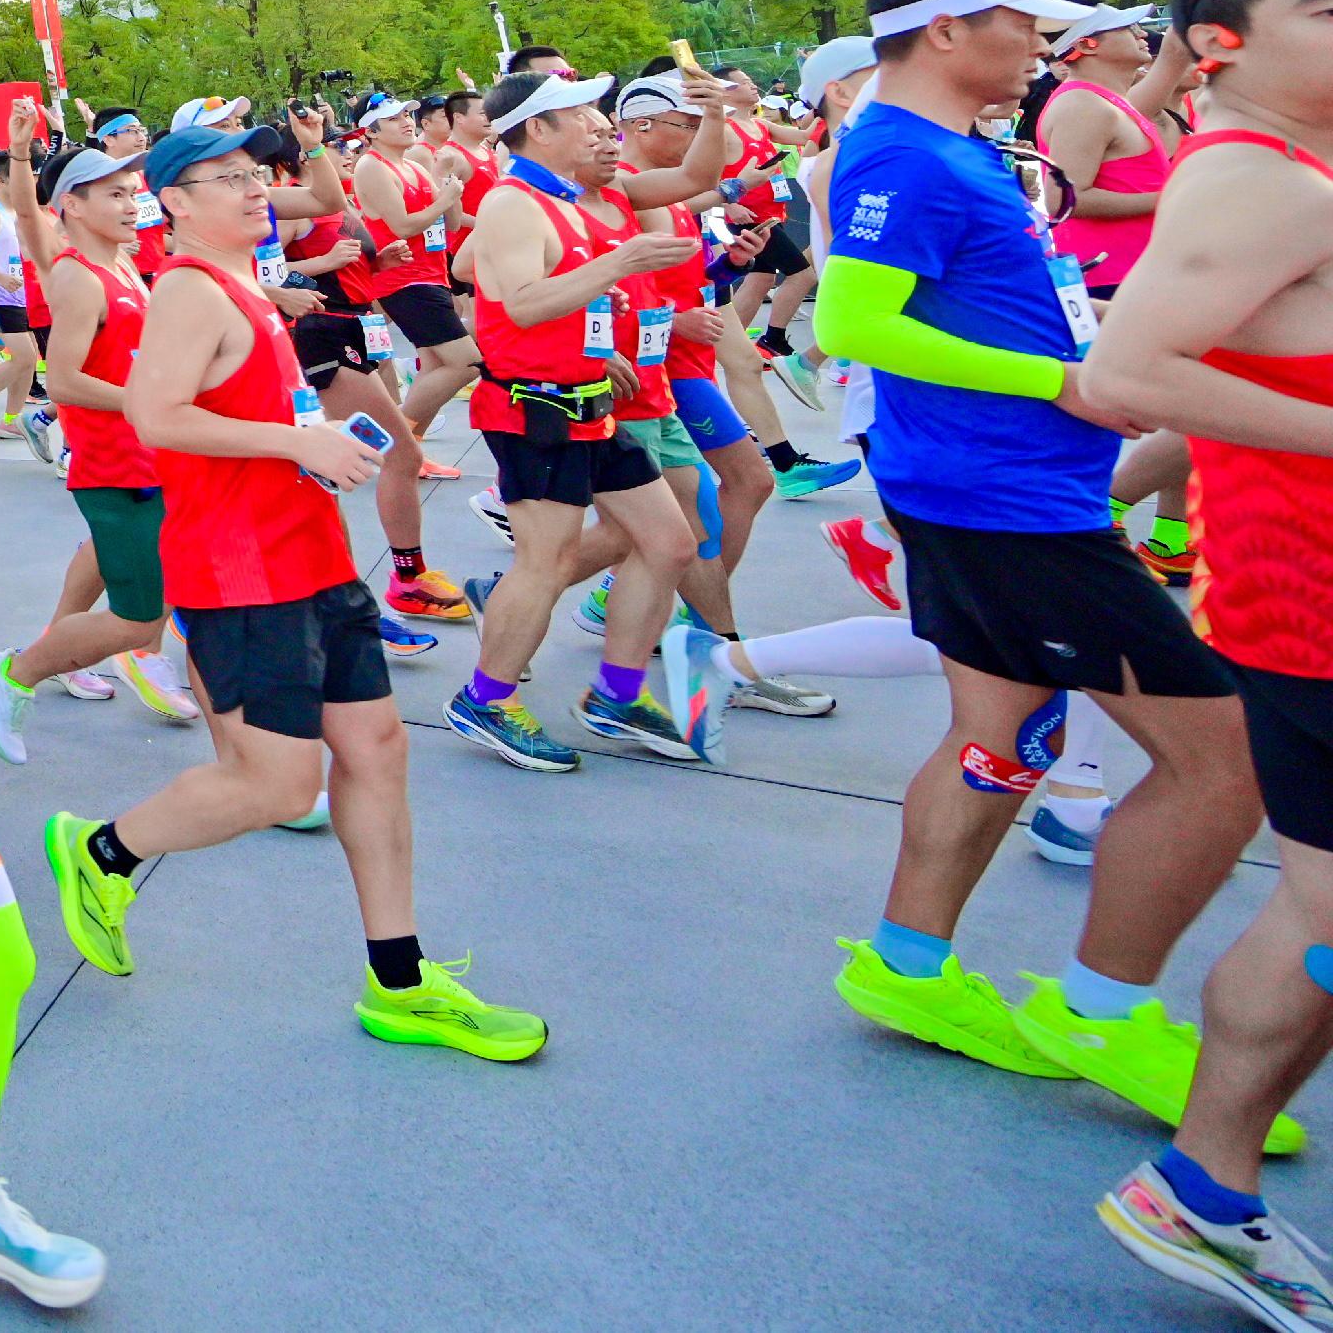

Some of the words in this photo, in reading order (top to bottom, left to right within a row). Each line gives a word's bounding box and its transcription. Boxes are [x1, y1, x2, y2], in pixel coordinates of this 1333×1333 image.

[262, 266, 270, 277] D
[1066, 299, 1081, 318] D
[593, 321, 601, 334] D
[644, 332, 651, 345] D
